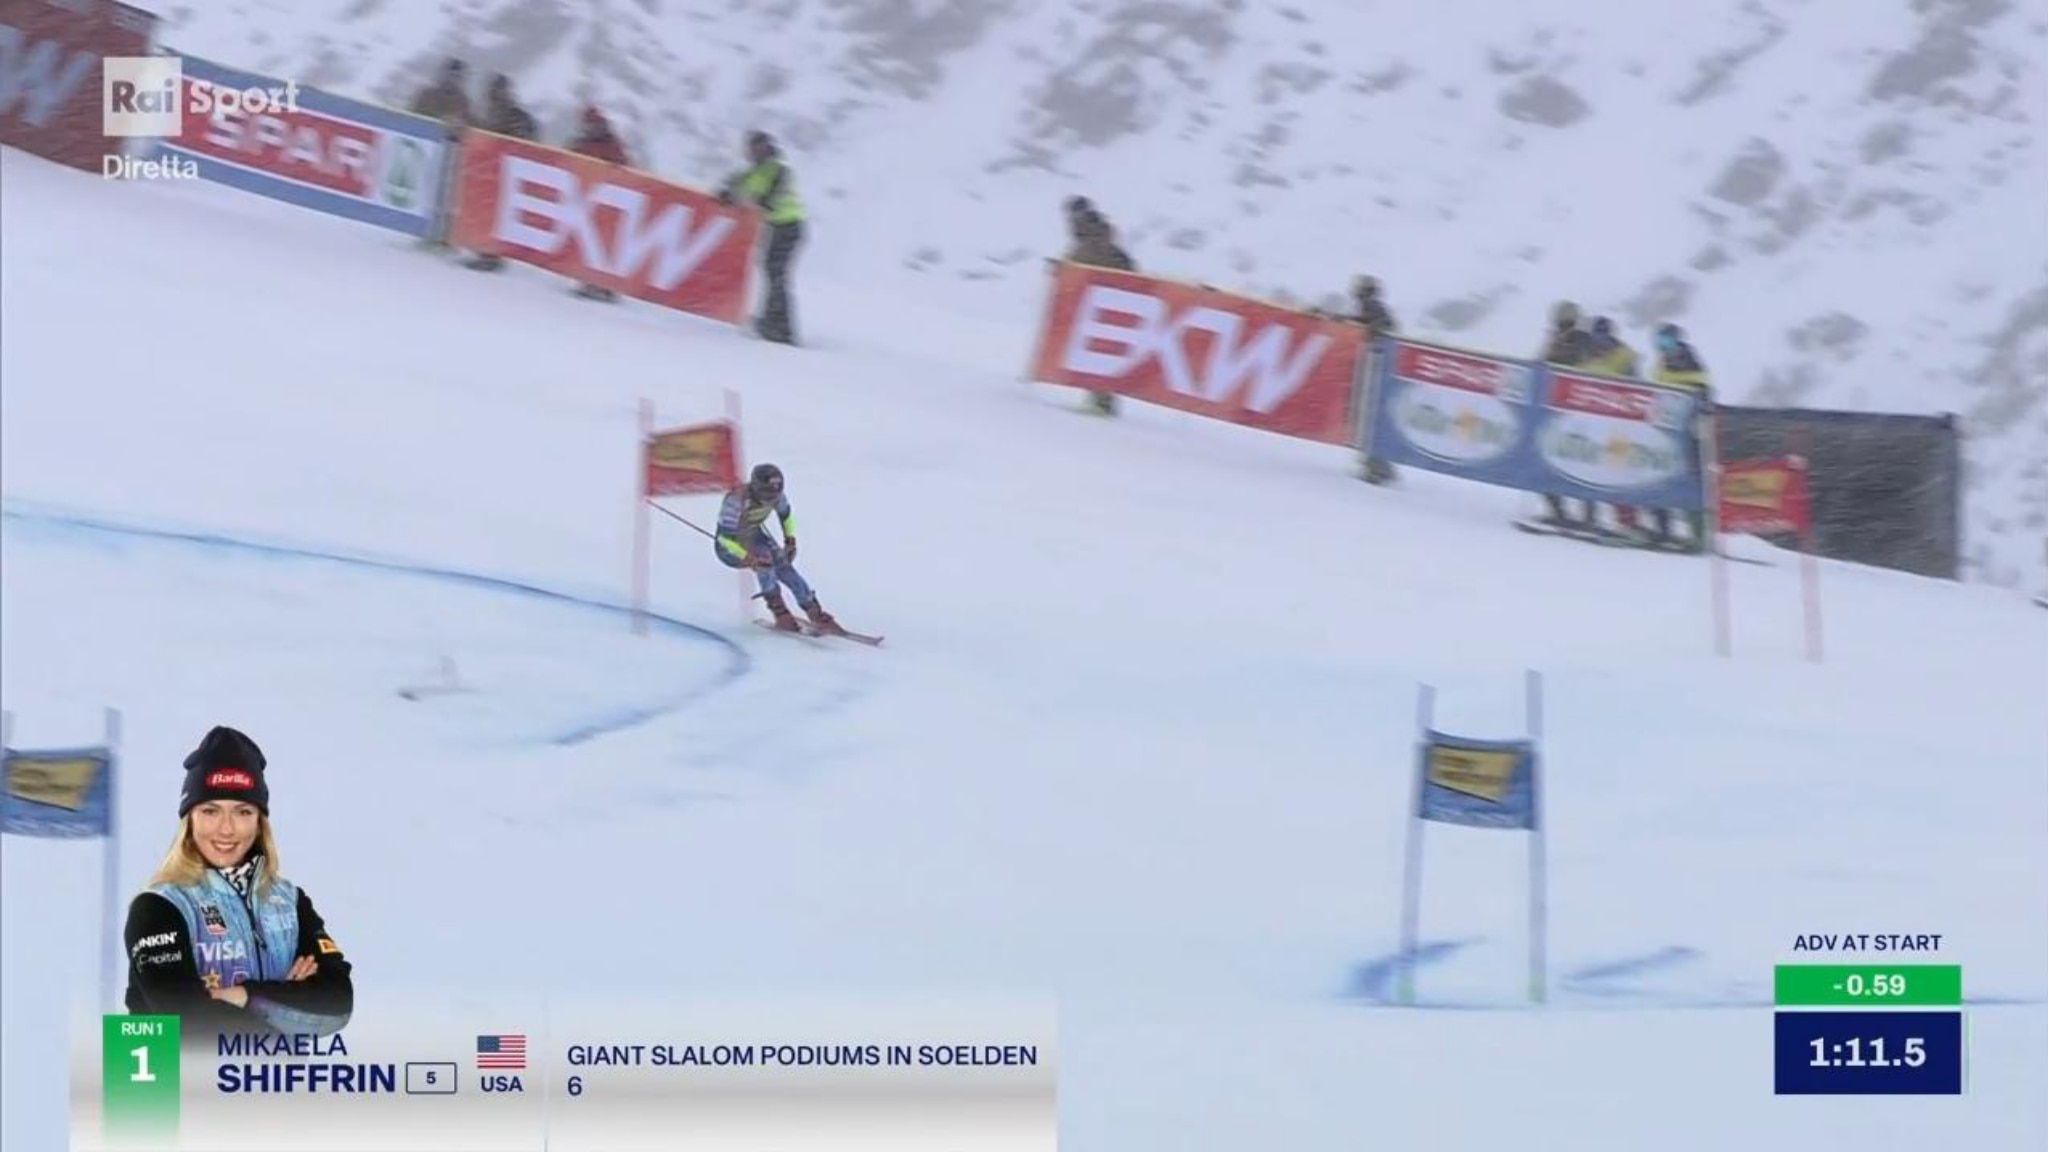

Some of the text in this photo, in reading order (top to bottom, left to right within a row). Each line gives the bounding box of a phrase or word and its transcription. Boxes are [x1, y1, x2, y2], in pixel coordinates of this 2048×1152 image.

[491, 153, 738, 291] BKW
[1061, 285, 1335, 415] BKW
[195, 939, 248, 962] VISA
